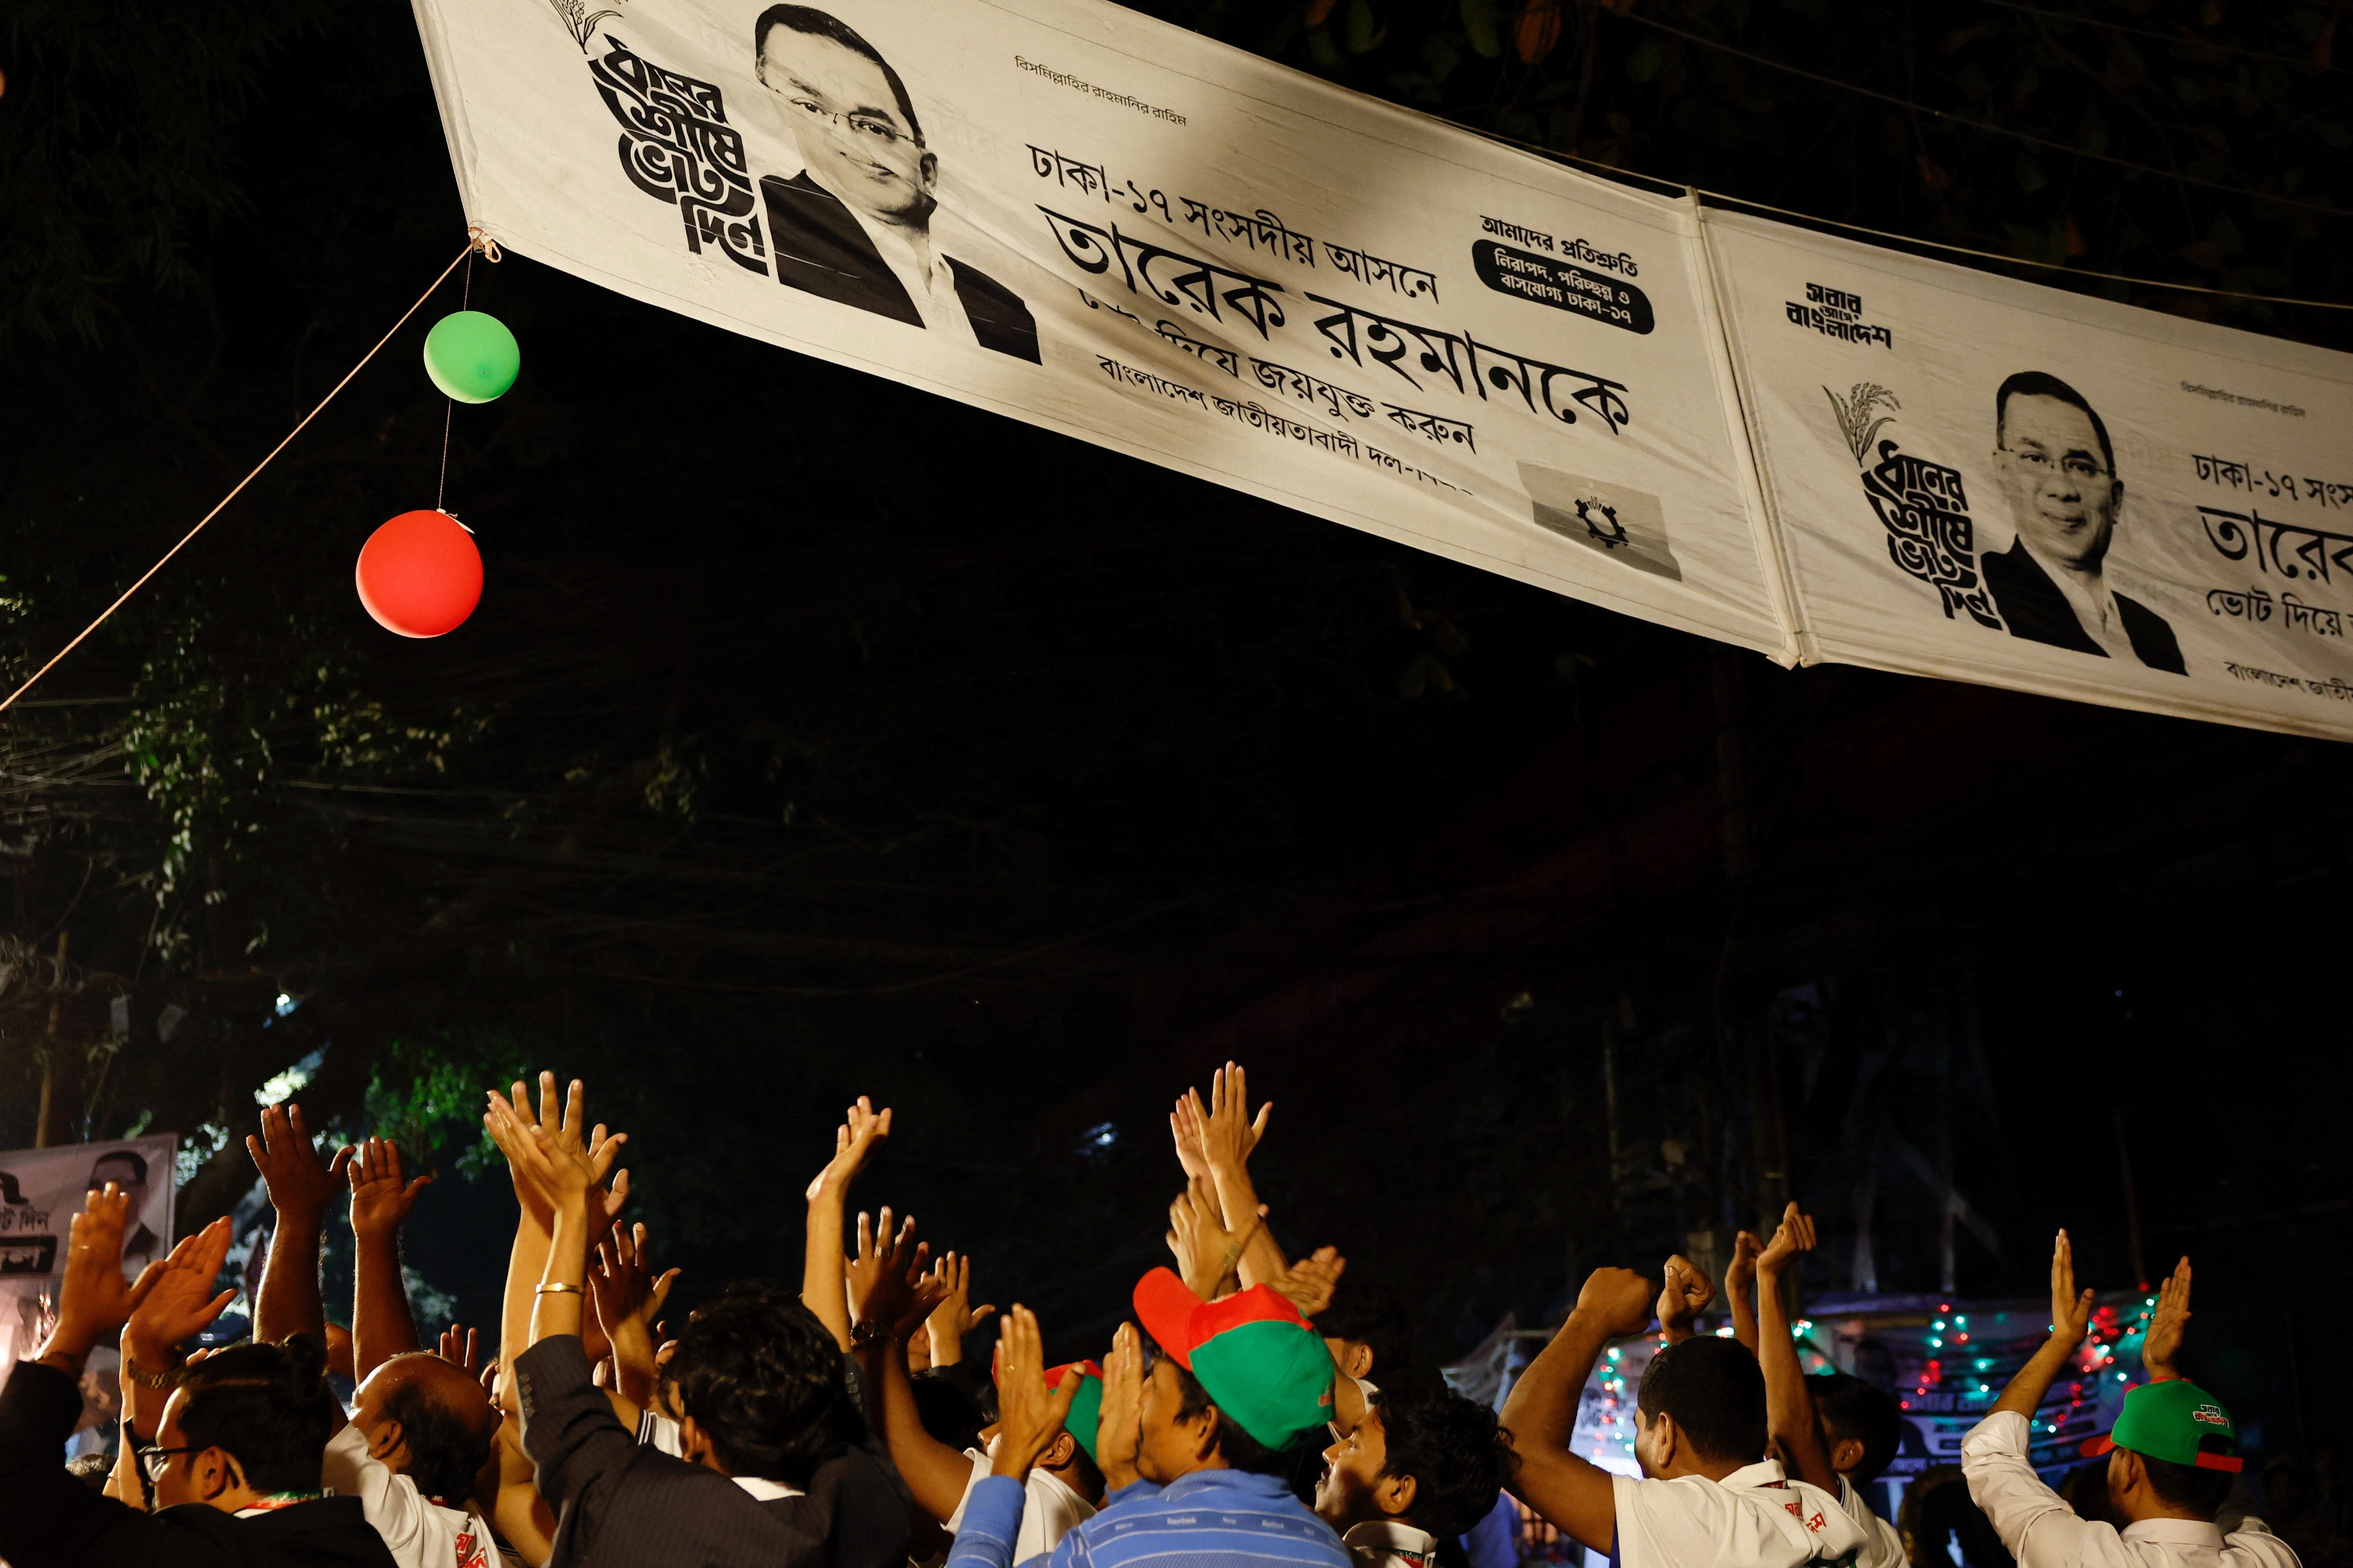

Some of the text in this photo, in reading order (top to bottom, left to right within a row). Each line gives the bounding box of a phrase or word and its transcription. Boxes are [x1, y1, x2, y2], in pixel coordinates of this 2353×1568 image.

[1015, 55, 1186, 127] বিসমিল্লাহির রাহমানির রাহিম
[680, 195, 769, 276] দিন
[1026, 143, 1440, 304] ঢাকা-১৭ সংসদীয় আসনে
[1480, 215, 1638, 277] আমাদের প্রতিশ্রুতি
[1494, 247, 1630, 305] নিরাপদ, পরিচ্ছন্ন ও
[1500, 272, 1632, 324] বাসযোগ্য ঢাকা-১৭
[1806, 283, 1862, 320] সবার
[1034, 204, 1630, 435] তারেক রহমানকে
[1786, 301, 1892, 350] বাংলাদেশ
[1095, 354, 1208, 410] বাংলাদেশ
[1212, 395, 1359, 460] জাতীয়তাবাদী
[1249, 357, 1375, 422] জয়যুক্ত
[1381, 401, 1476, 455] করুন
[2191, 455, 2299, 501] ঢাকা-১৭
[1931, 579, 2003, 631] দিন
[2207, 586, 2343, 637] ভোট দিয়ে
